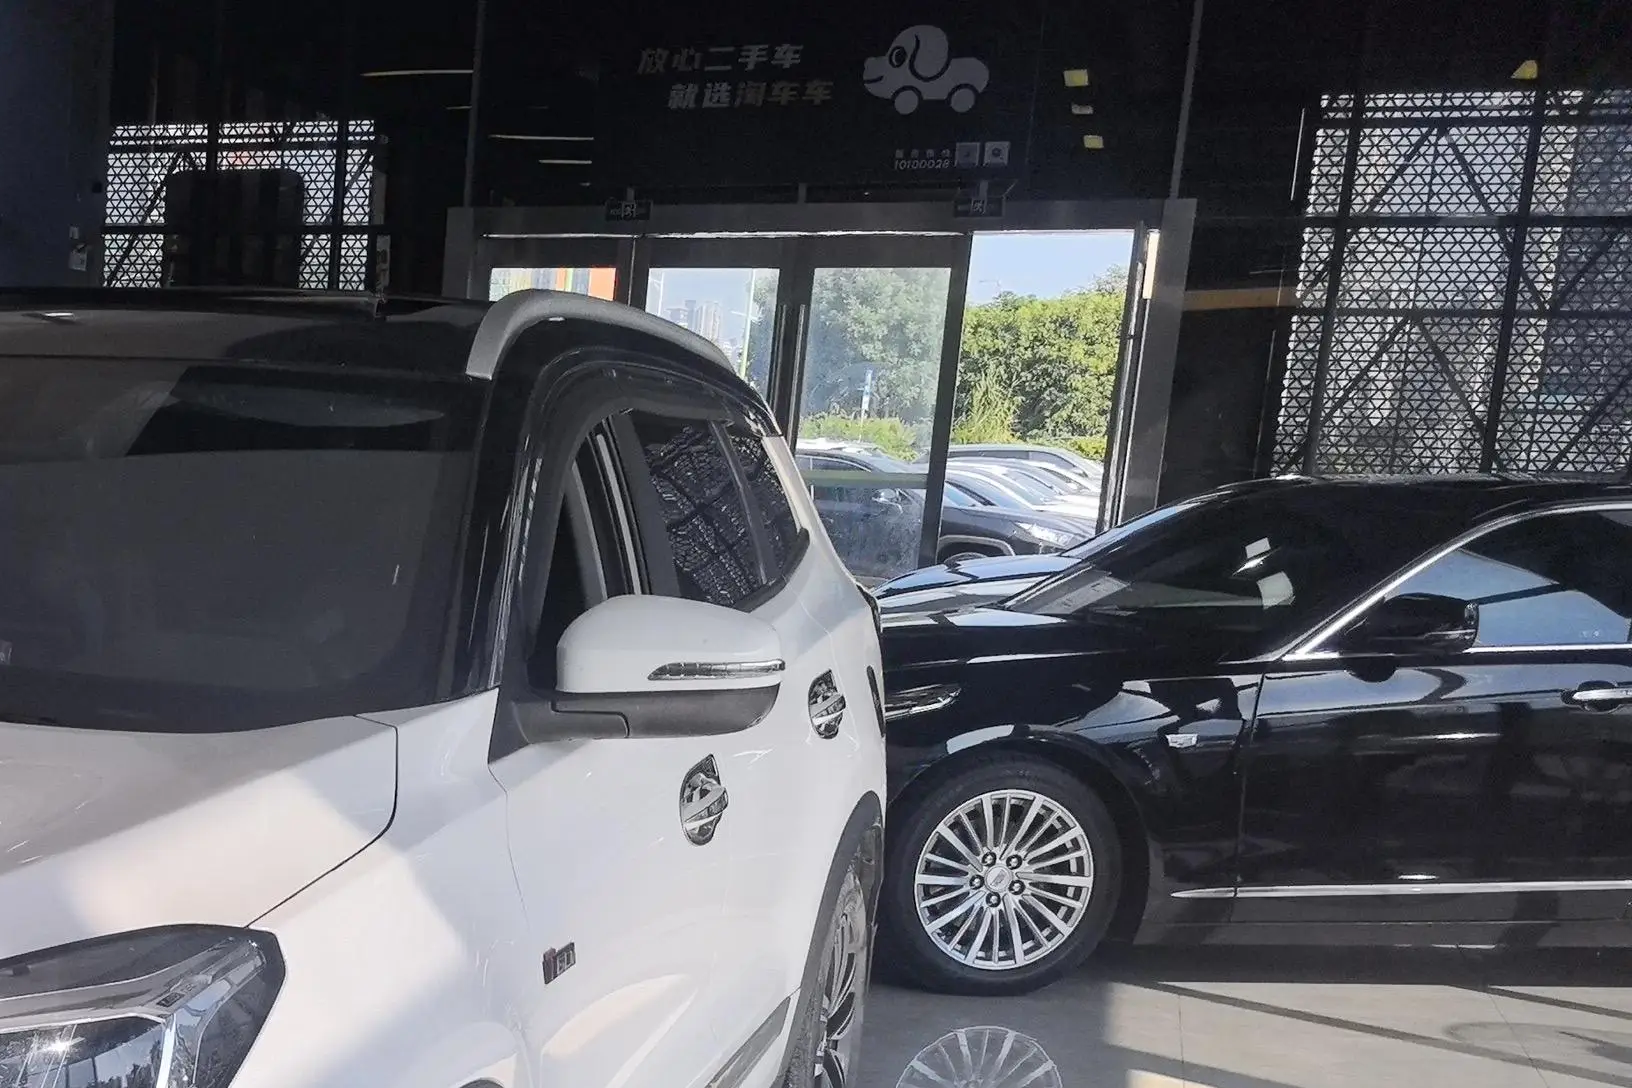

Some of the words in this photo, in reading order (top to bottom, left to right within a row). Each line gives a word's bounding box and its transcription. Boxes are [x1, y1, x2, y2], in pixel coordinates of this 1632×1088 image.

[666, 80, 835, 110] 就选淘车车
